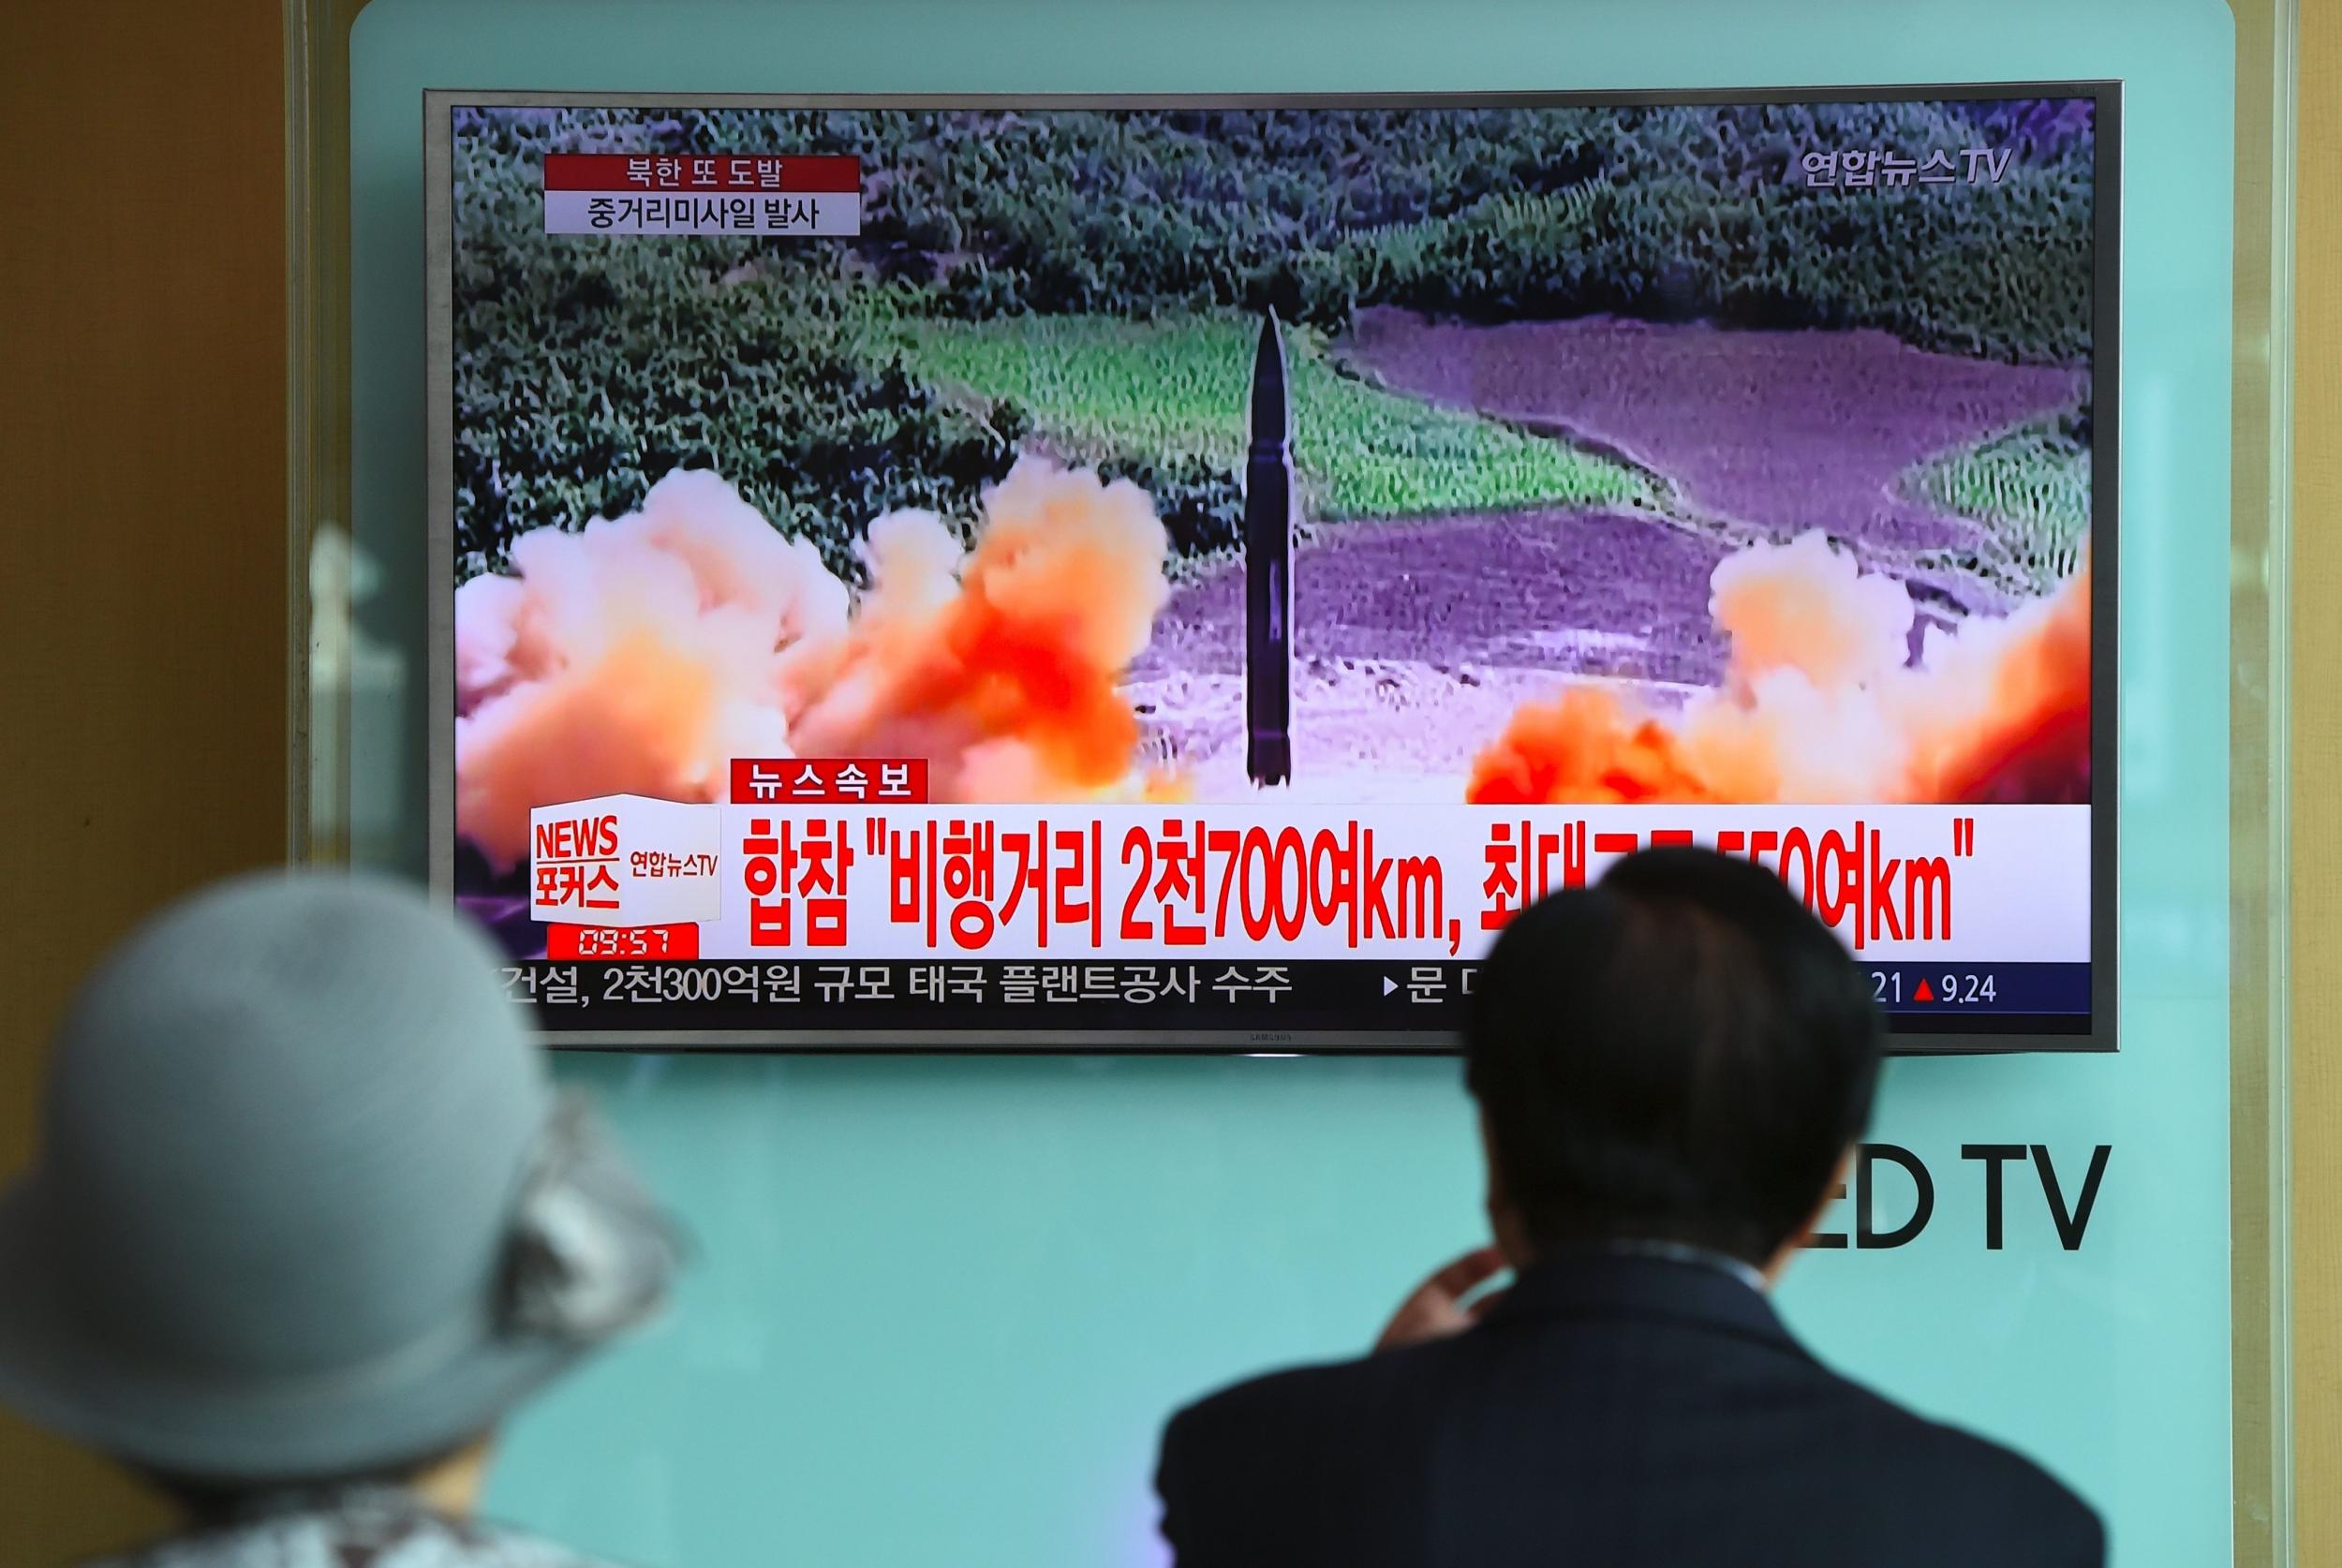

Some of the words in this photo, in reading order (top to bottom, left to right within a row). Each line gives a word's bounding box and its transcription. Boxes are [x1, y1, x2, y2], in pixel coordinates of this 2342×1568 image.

[627, 158, 682, 187] 북한
[691, 158, 719, 186] 또
[728, 158, 783, 187] 도발
[1801, 148, 2012, 187] 연합뉴스TV
[587, 198, 756, 229] 중거리미사일
[764, 198, 820, 229] 발사
[749, 763, 912, 799] 뉴스속보
[536, 815, 618, 859] NEWS
[630, 851, 719, 878] 연합뉴스TV
[535, 865, 620, 910] 포커스
[743, 818, 854, 947] 합참
[866, 817, 1102, 950] "비행거리
[1119, 820, 1461, 956] 2천700여km,
[578, 929, 669, 955] 09:57
[491, 965, 590, 1008] 건설,
[602, 965, 802, 1004] 2천300억원
[813, 966, 896, 1003] 규모
[909, 966, 987, 1003] 태국
[999, 965, 1201, 1004] 플랜트공사
[1211, 966, 1293, 1004] 수주
[1406, 966, 1447, 1003] 문
[1871, 970, 1902, 1003] 21
[1941, 973, 1997, 1004] 9.24
[1961, 1144, 2112, 1251] TV
